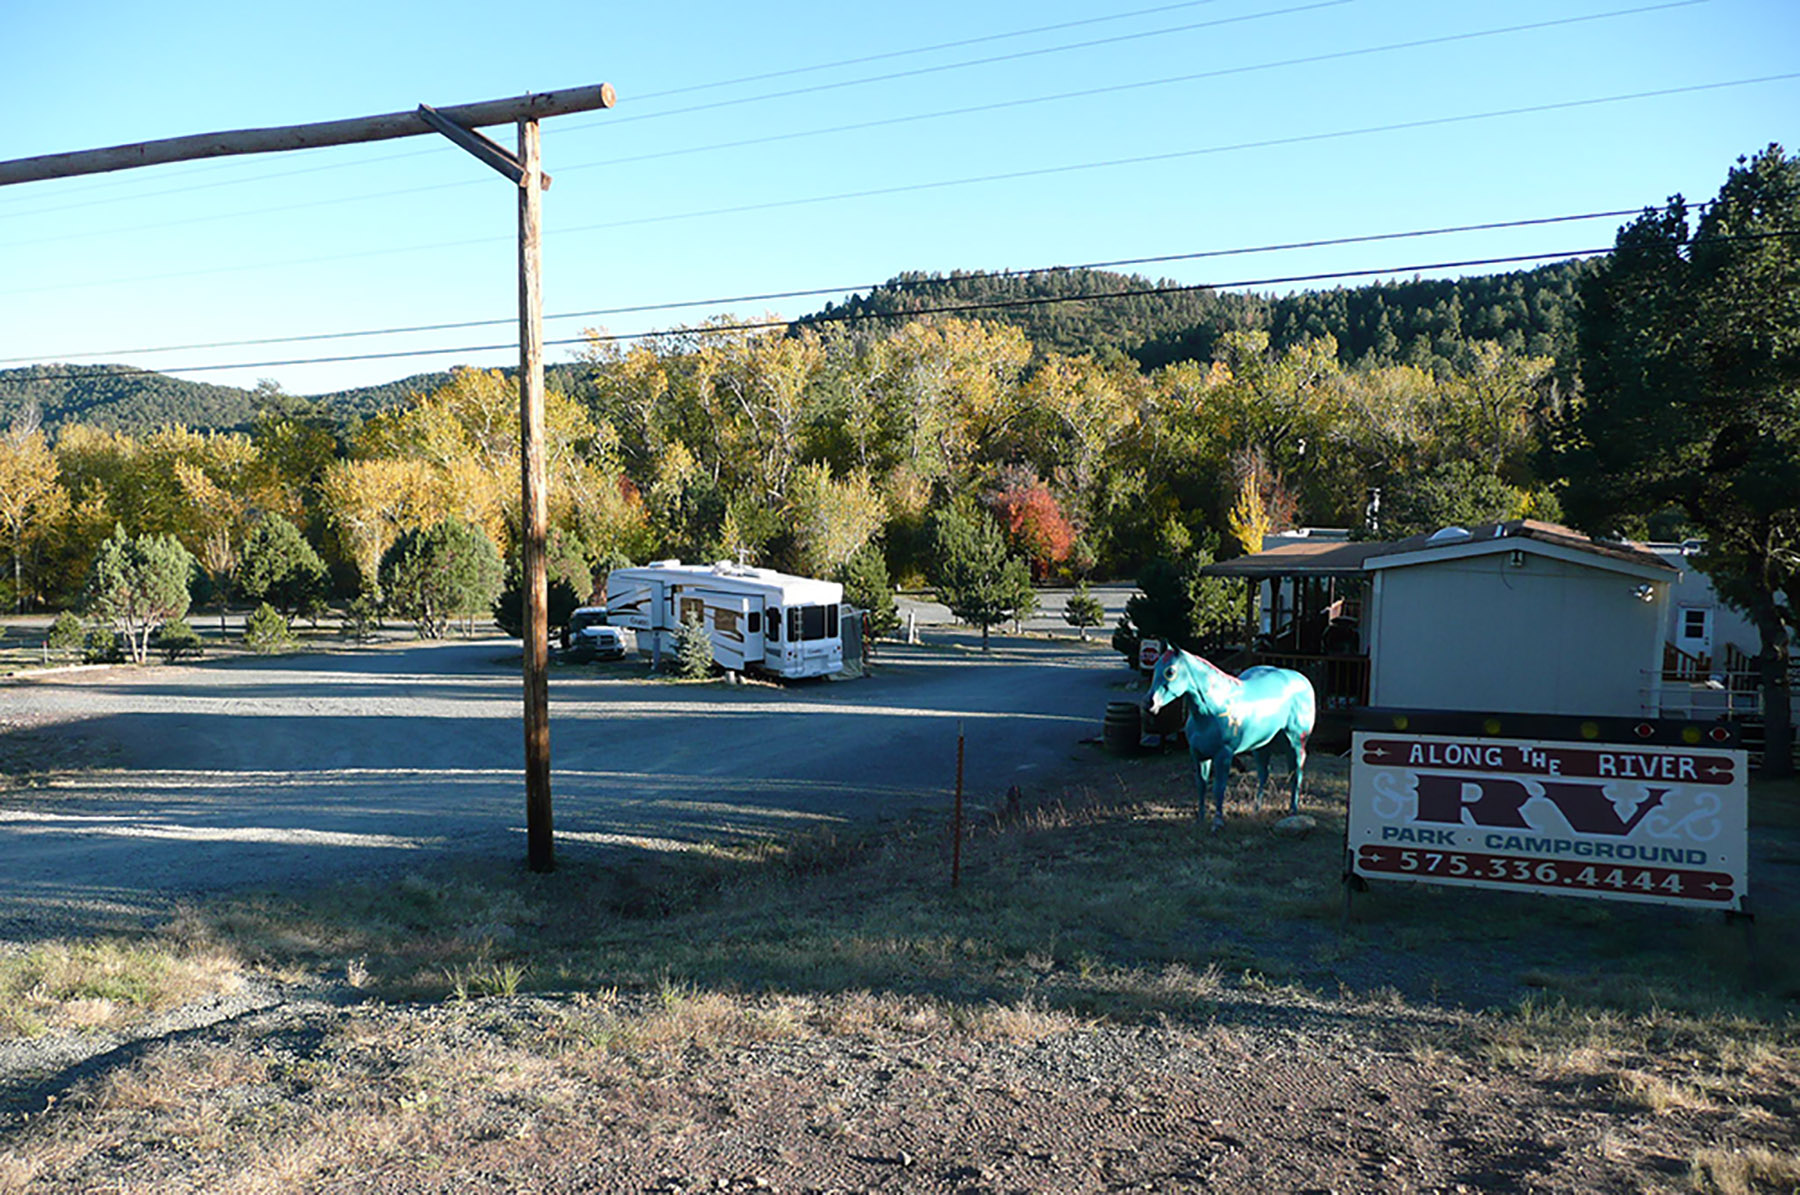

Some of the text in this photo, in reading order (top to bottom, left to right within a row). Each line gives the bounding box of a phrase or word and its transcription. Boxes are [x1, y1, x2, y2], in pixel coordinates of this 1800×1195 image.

[1409, 743, 1698, 780] ALONG THE RIVER
[1412, 773, 1671, 836] RV
[1381, 826, 1708, 865] PARK CAMPGROUND
[1399, 851, 1684, 894] 575.336.4444
